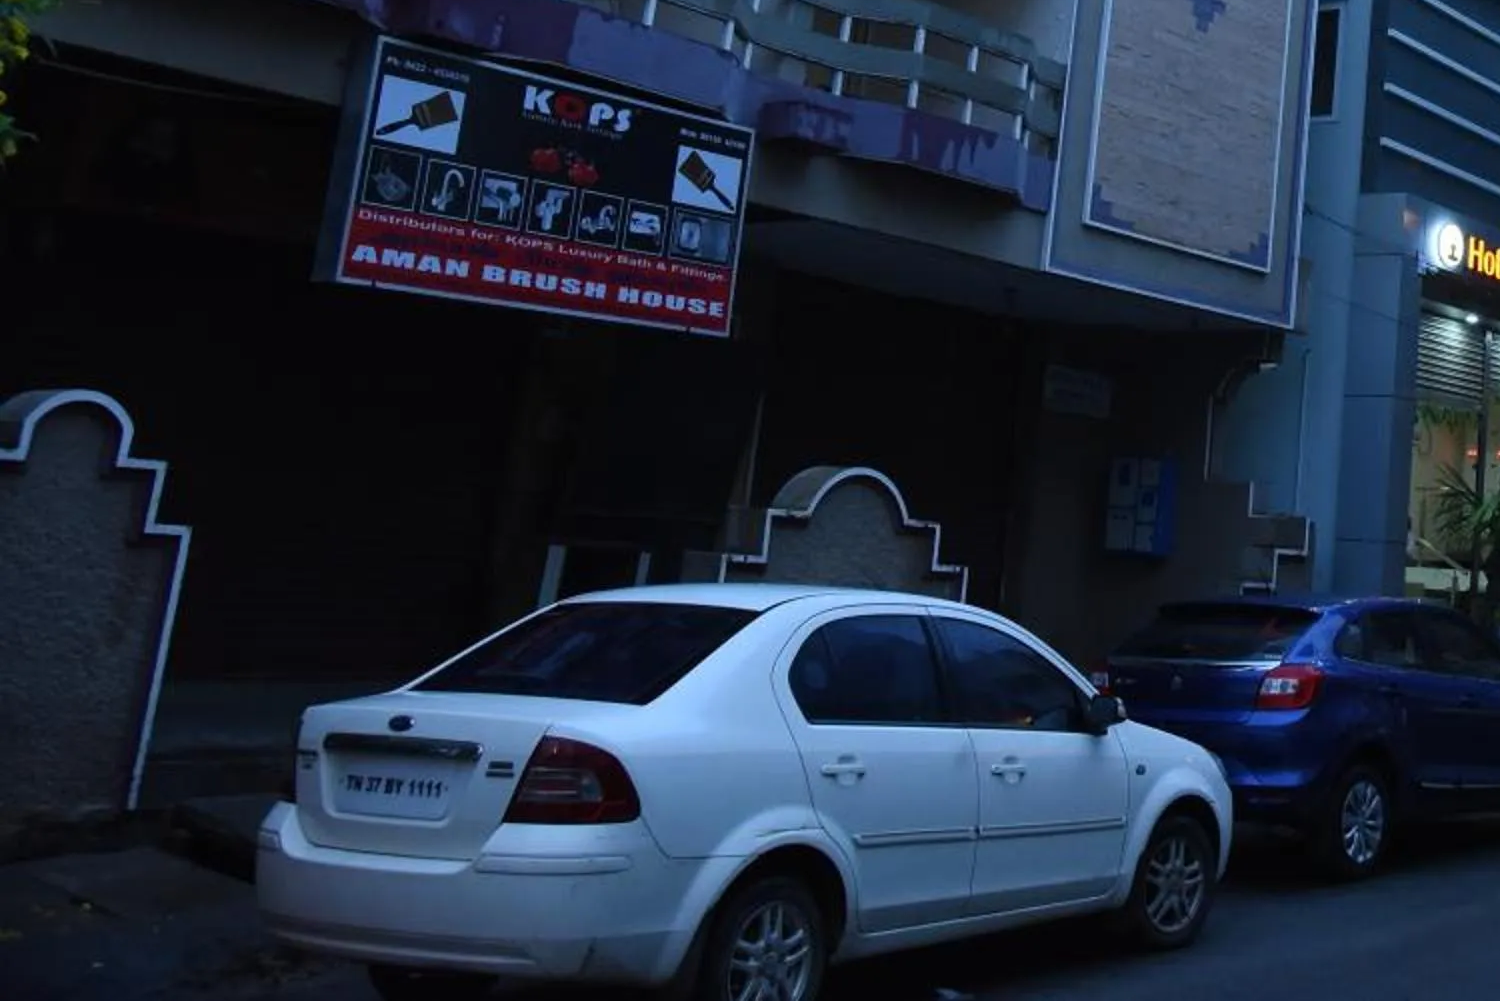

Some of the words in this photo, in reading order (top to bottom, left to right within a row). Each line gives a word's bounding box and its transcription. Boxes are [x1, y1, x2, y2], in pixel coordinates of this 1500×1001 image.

[523, 84, 633, 133] KOPS
[358, 208, 465, 237] Distributors
[505, 234, 553, 251] KOPS
[559, 243, 613, 264] Luxury
[617, 254, 651, 270] Bath
[656, 262, 667, 272] &
[352, 244, 470, 278] AMAN
[482, 264, 607, 299] BRUSH
[617, 286, 725, 318] HOUSE
[346, 775, 363, 792] TN
[366, 776, 381, 793] 37
[409, 779, 443, 798] 1111
